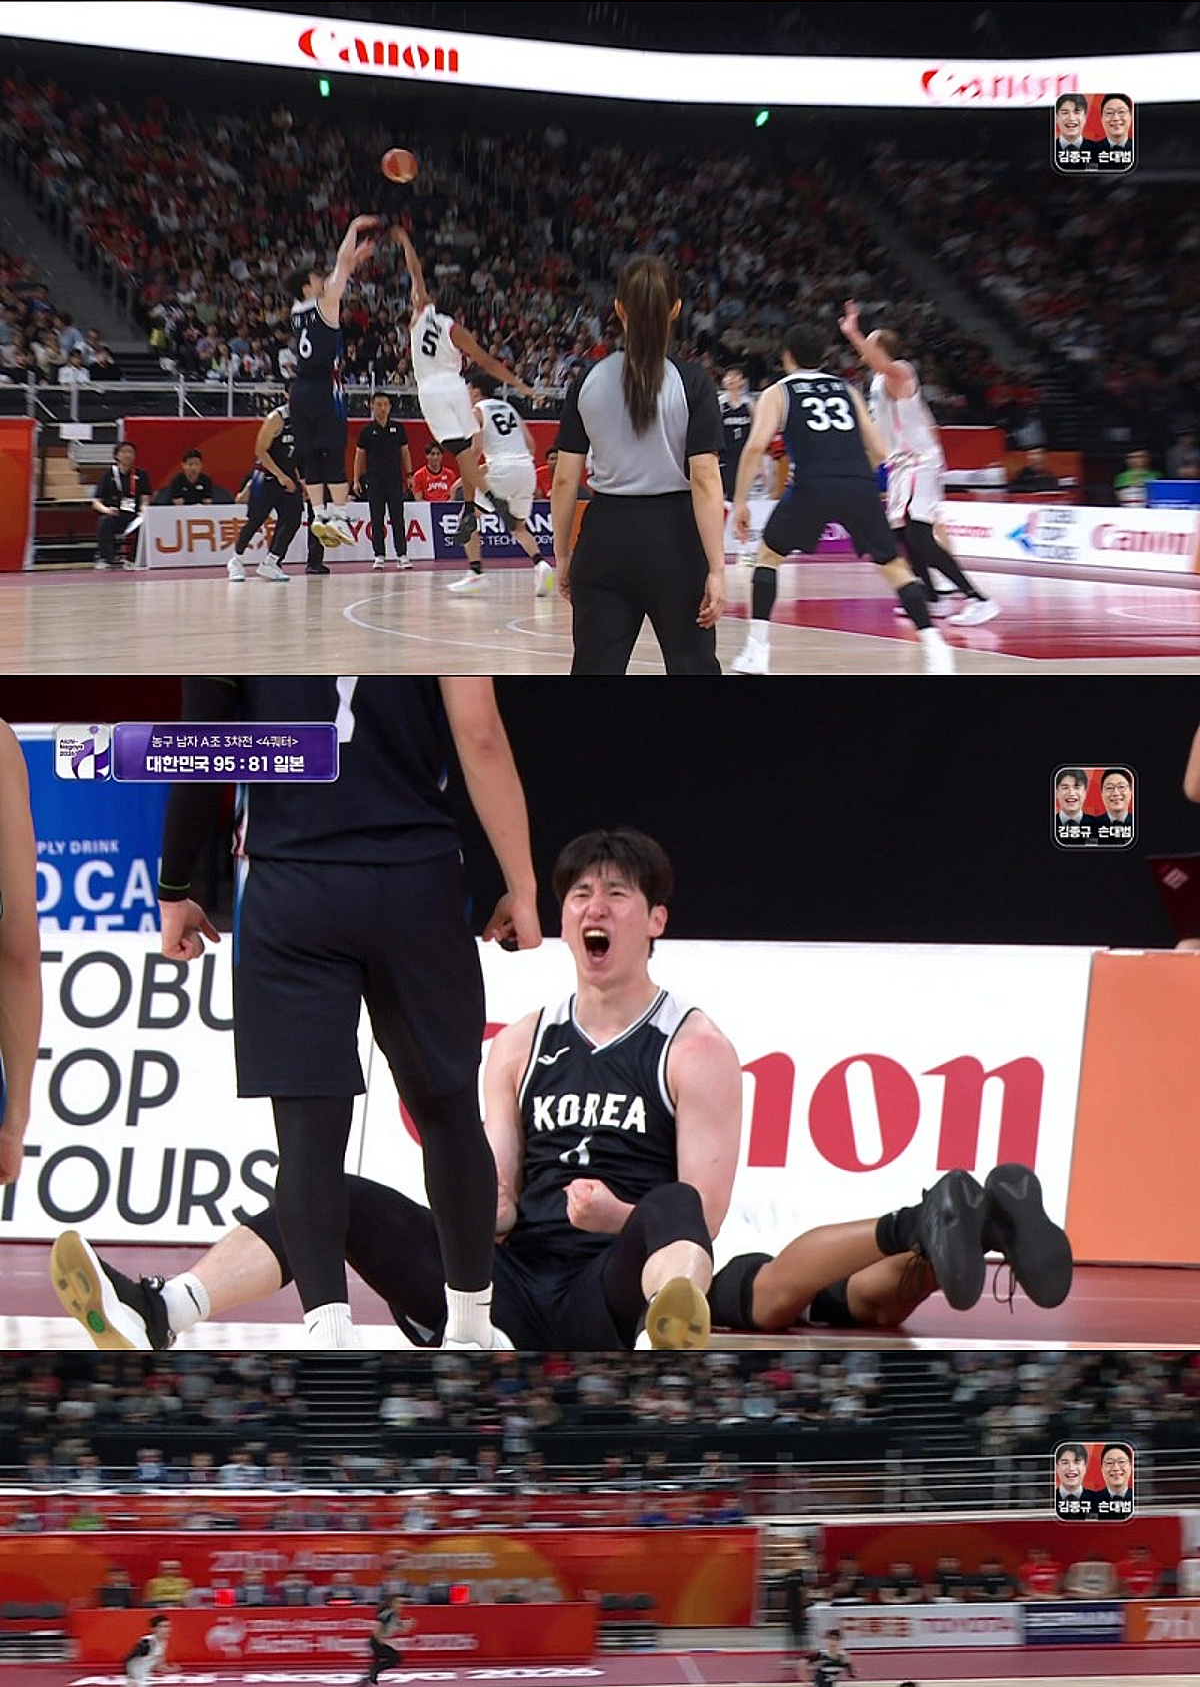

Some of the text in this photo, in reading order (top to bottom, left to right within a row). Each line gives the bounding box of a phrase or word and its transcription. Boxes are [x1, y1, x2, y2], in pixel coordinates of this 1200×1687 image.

[298, 26, 460, 73] Canon
[921, 67, 1079, 101] Canon
[298, 330, 312, 359] 6
[421, 328, 438, 357] 5
[491, 412, 517, 436] 64
[801, 396, 855, 432] 33
[1090, 522, 1192, 556] Canon
[69, 838, 120, 853] DRINK
[533, 1092, 646, 1134] KOREA
